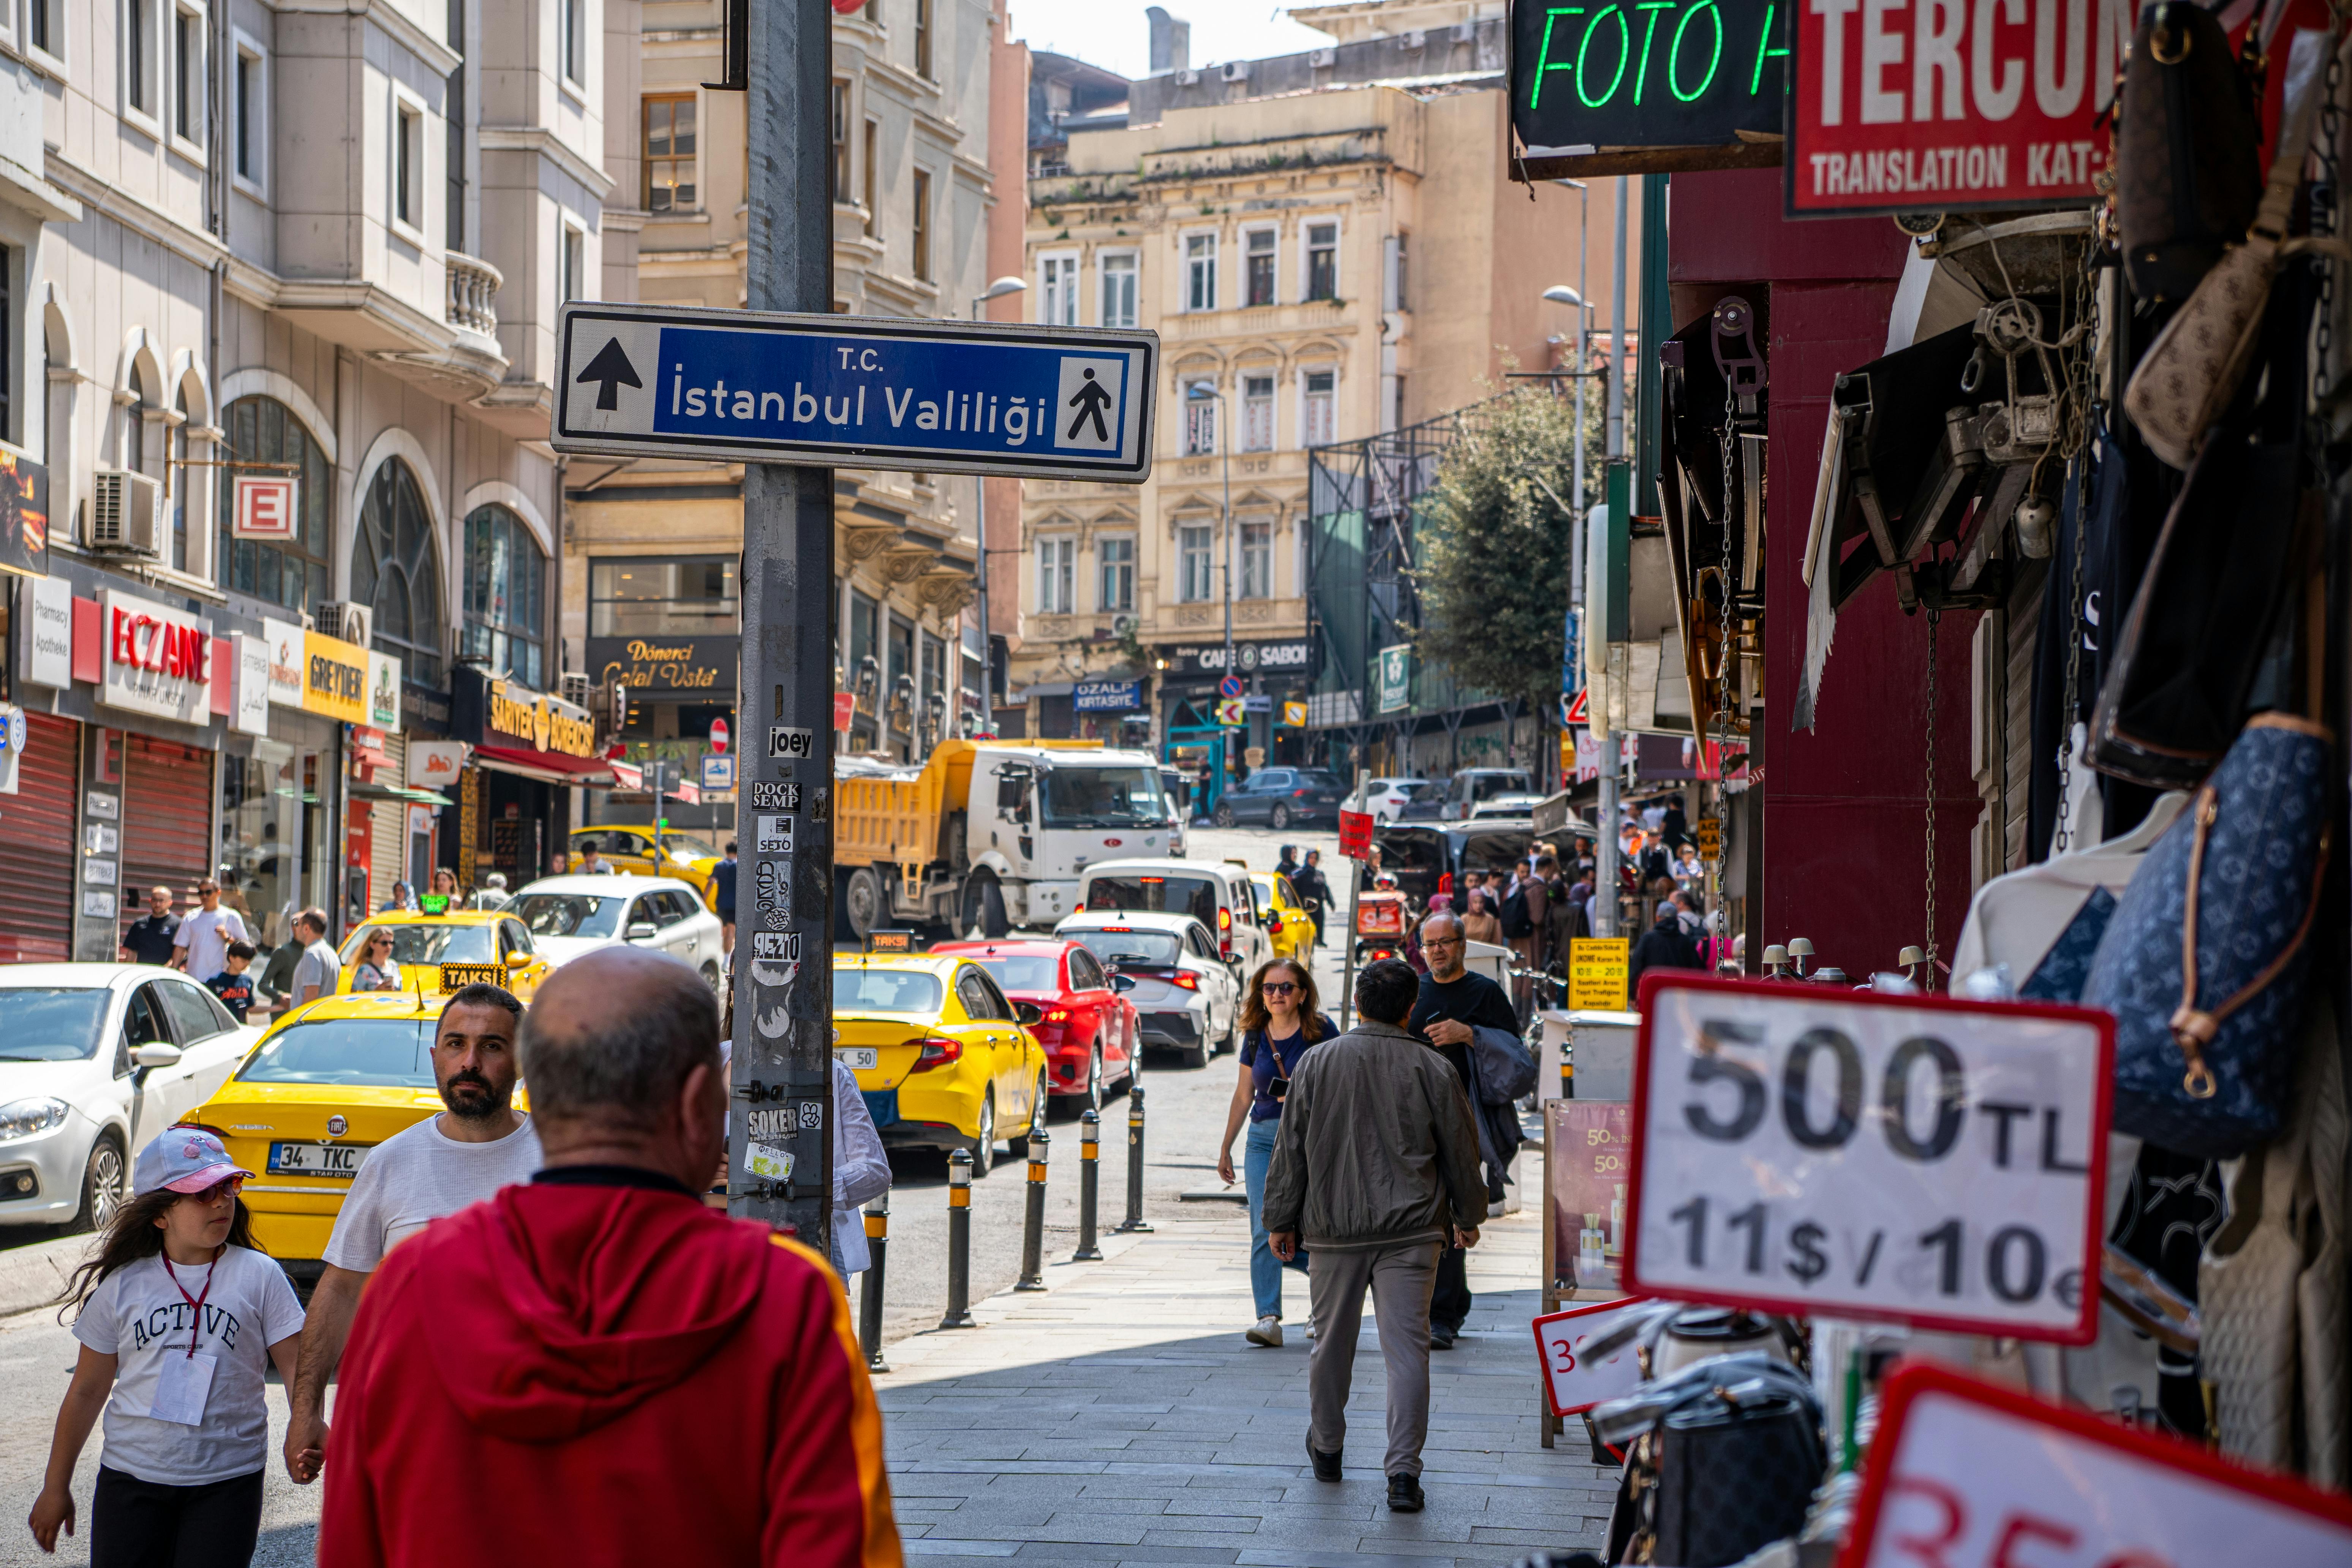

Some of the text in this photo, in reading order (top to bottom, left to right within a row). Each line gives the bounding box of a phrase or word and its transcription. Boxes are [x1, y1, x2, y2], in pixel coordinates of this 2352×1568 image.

[1531, 0, 1723, 109] FOTO
[1810, 146, 2008, 196] TRANSLATION
[838, 347, 883, 371] T.C.
[672, 363, 1046, 447] İstanbul Valiliği
[250, 488, 278, 526] E
[35, 600, 68, 629] Pharmacy
[36, 634, 68, 658] Apotheke
[112, 605, 211, 686] ECZANE
[1261, 644, 1307, 666] SABO
[242, 653, 266, 673] аптека
[310, 654, 362, 702] GREYDER
[659, 663, 716, 688] Usta
[770, 727, 811, 757] joey
[754, 783, 799, 796] DOCK
[754, 794, 798, 808] SEMP
[857, 1052, 872, 1065] 50
[330, 1122, 343, 1132] FIAT
[749, 1109, 797, 1135] SOKER
[281, 1146, 303, 1167] 34
[323, 1148, 356, 1170] TKC
[759, 1145, 785, 1158] HELLO
[1594, 1155, 1626, 1173] 50%
[1671, 1195, 1829, 1286] 11$
